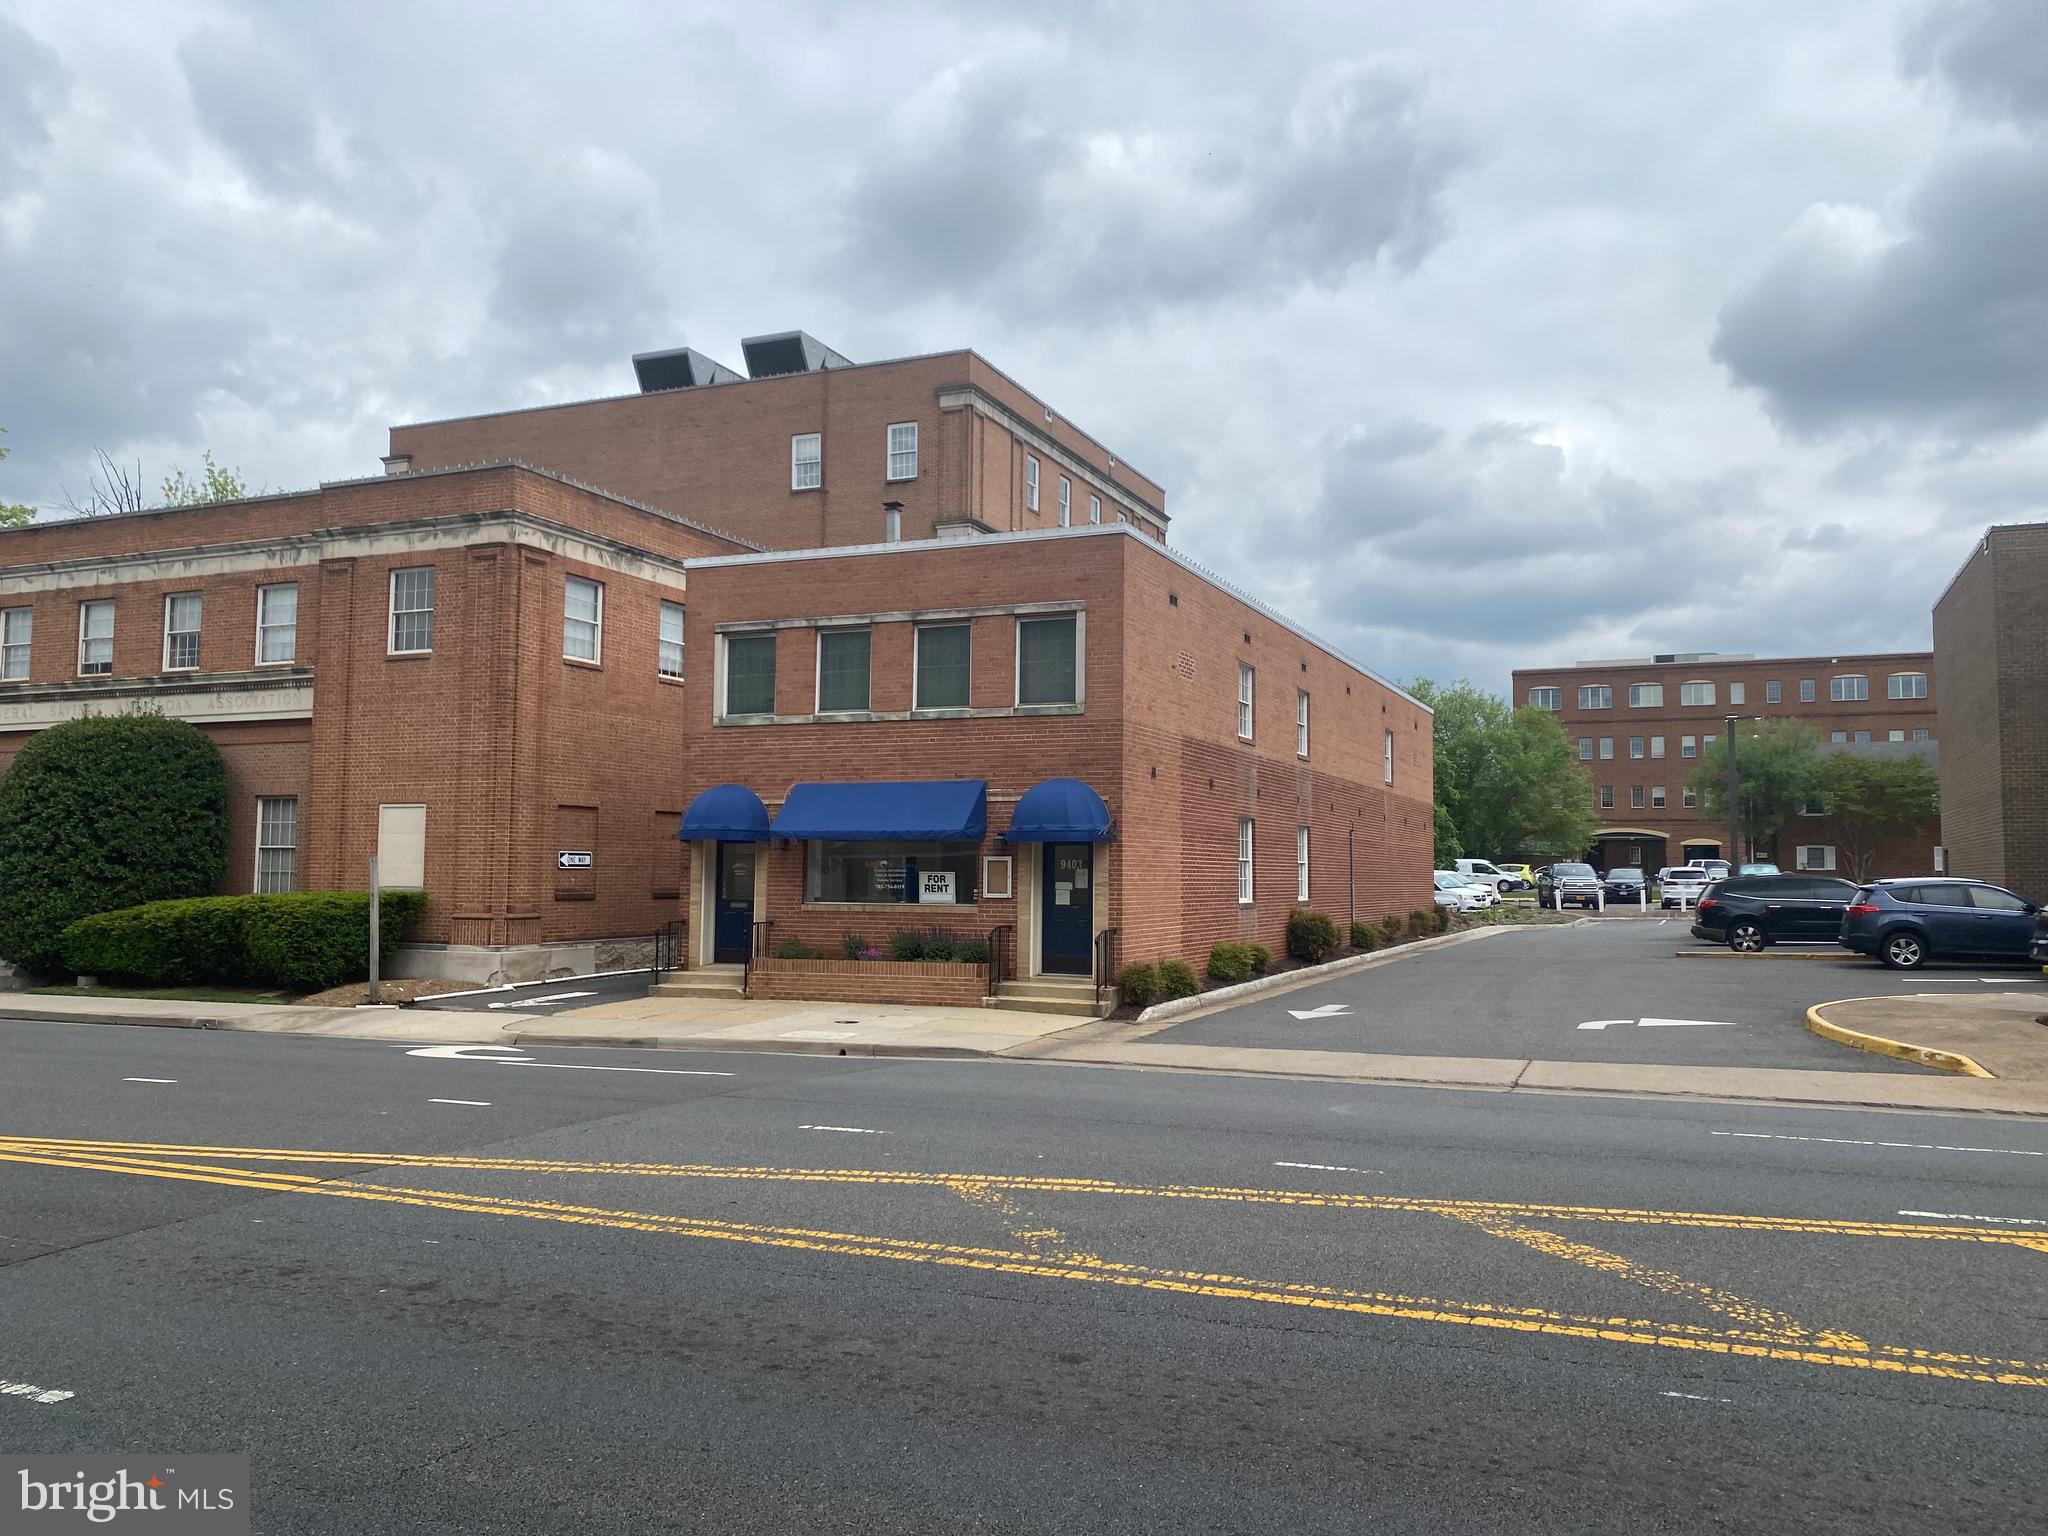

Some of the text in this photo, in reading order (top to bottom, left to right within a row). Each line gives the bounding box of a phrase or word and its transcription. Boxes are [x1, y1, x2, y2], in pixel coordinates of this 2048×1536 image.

[207, 693, 302, 711] ASSOCIATION
[927, 875, 946, 883] FOR
[924, 884, 949, 892] RENT
